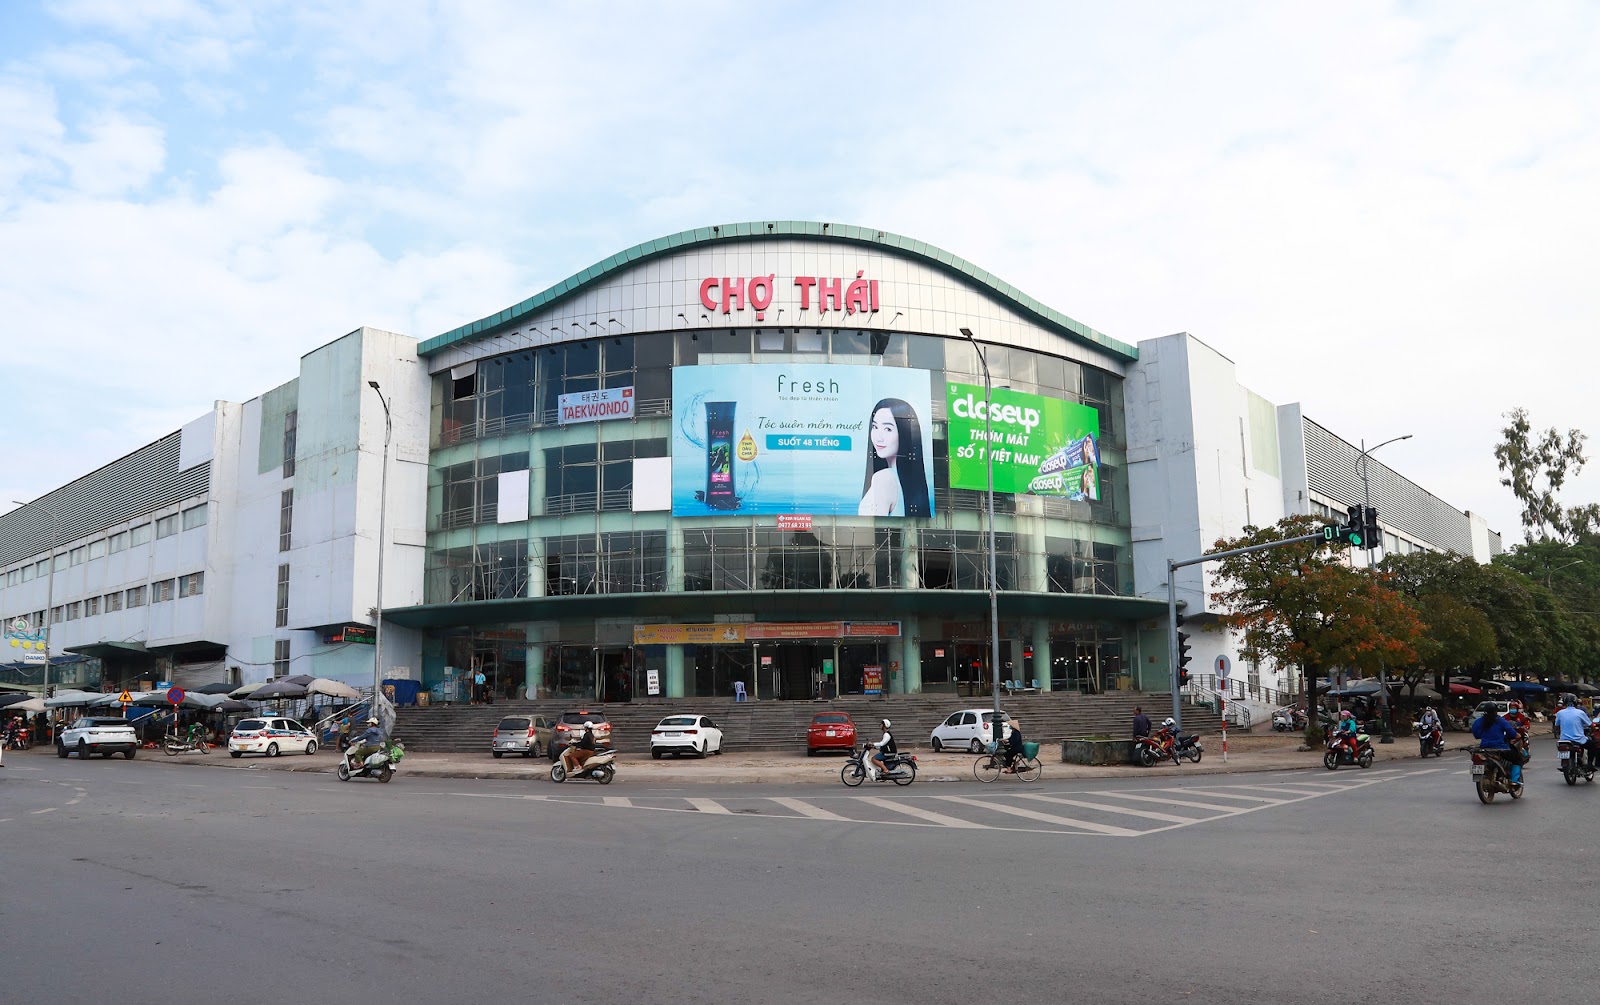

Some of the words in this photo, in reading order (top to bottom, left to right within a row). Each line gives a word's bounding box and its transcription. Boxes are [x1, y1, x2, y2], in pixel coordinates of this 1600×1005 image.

[700, 273, 775, 321] CHỢ
[794, 269, 879, 315] THÁI
[778, 374, 839, 394] fresh
[563, 400, 629, 420] TAEKWONDO
[953, 393, 1039, 434] closeup
[758, 416, 777, 430] Tóc
[779, 419, 804, 429] suôn
[807, 418, 833, 430] mềm
[778, 435, 802, 446] SUỐT
[814, 436, 840, 447] TIẾNG
[1006, 432, 1029, 446] MÁT
[956, 443, 976, 459] SỐ
[979, 447, 985, 460] 1
[1042, 455, 1067, 473] closeup
[1033, 477, 1063, 493] closeup
[1324, 525, 1340, 540] 01
